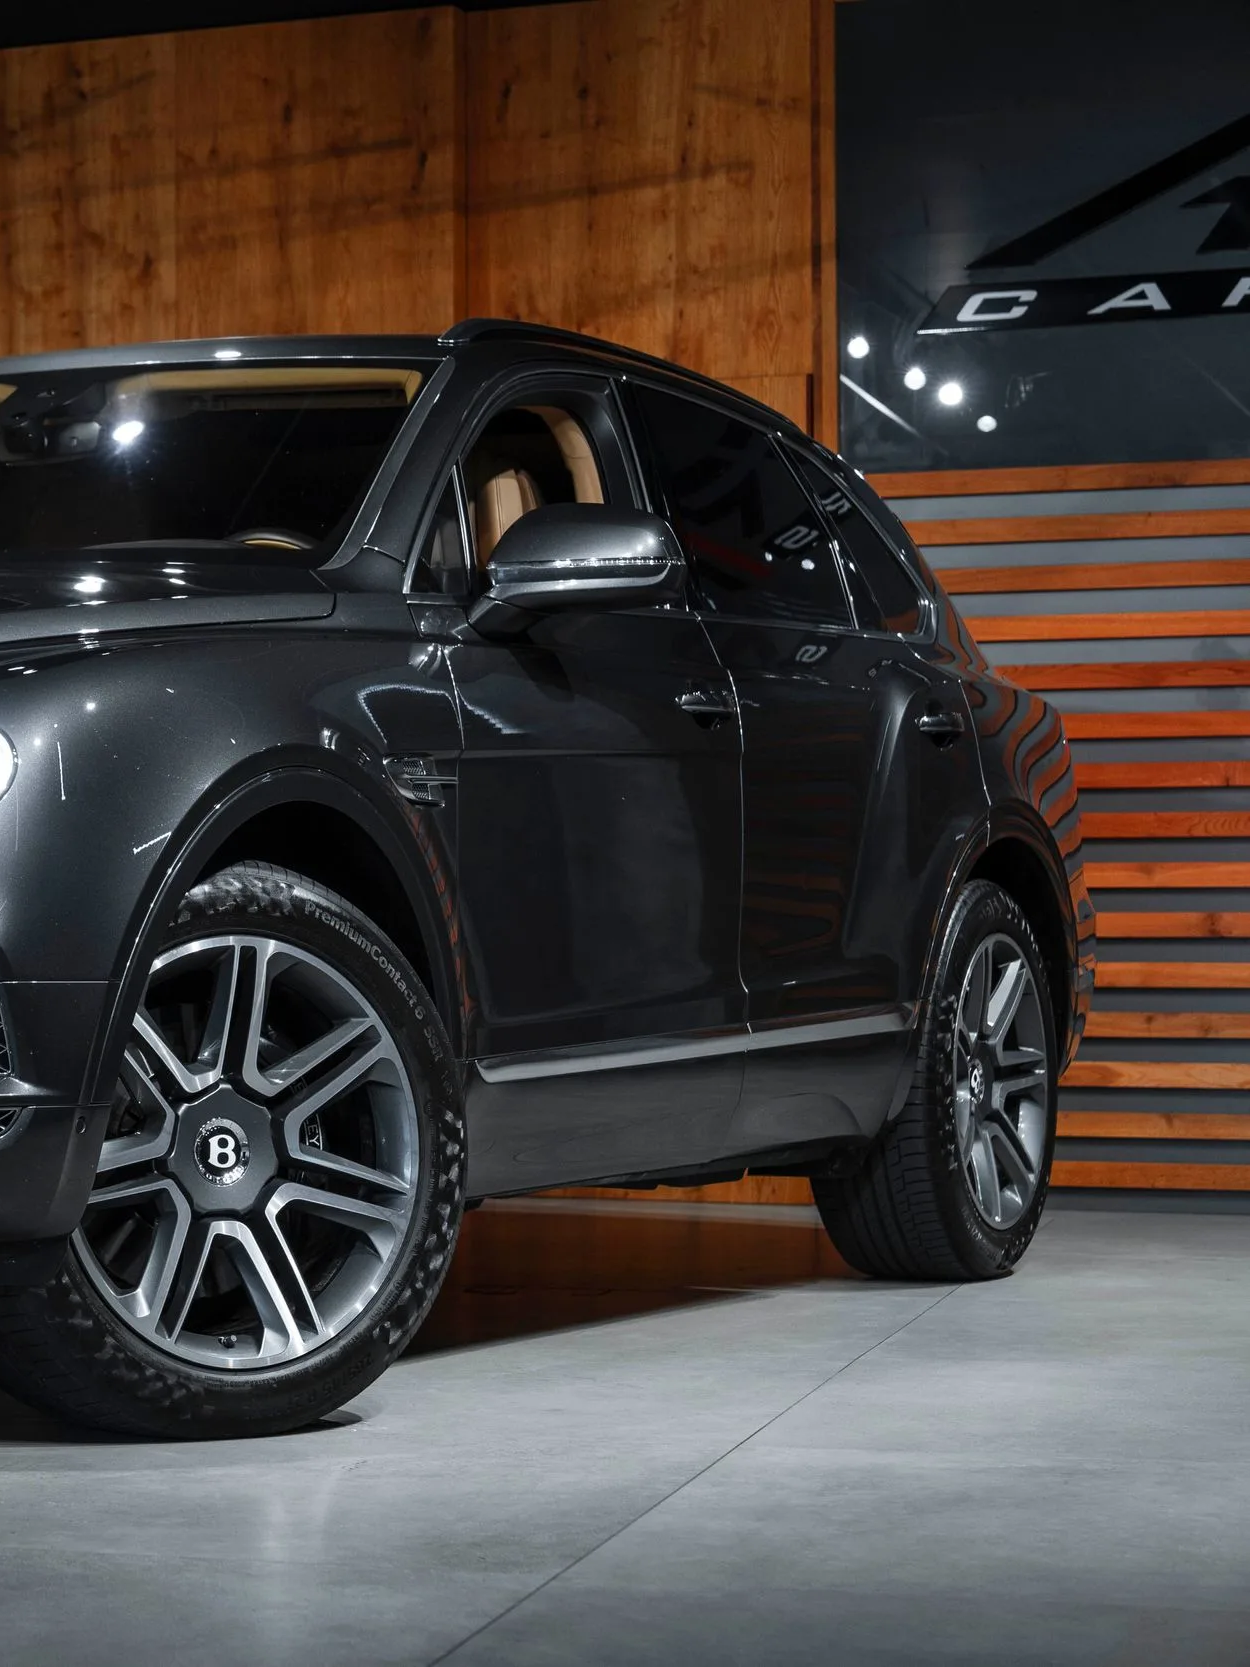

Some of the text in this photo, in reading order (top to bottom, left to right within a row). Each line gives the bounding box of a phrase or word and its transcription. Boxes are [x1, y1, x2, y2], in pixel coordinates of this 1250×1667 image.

[304, 899, 417, 1009] PremiumContact
[415, 1005, 426, 1020] 6
[208, 1134, 237, 1169] B
